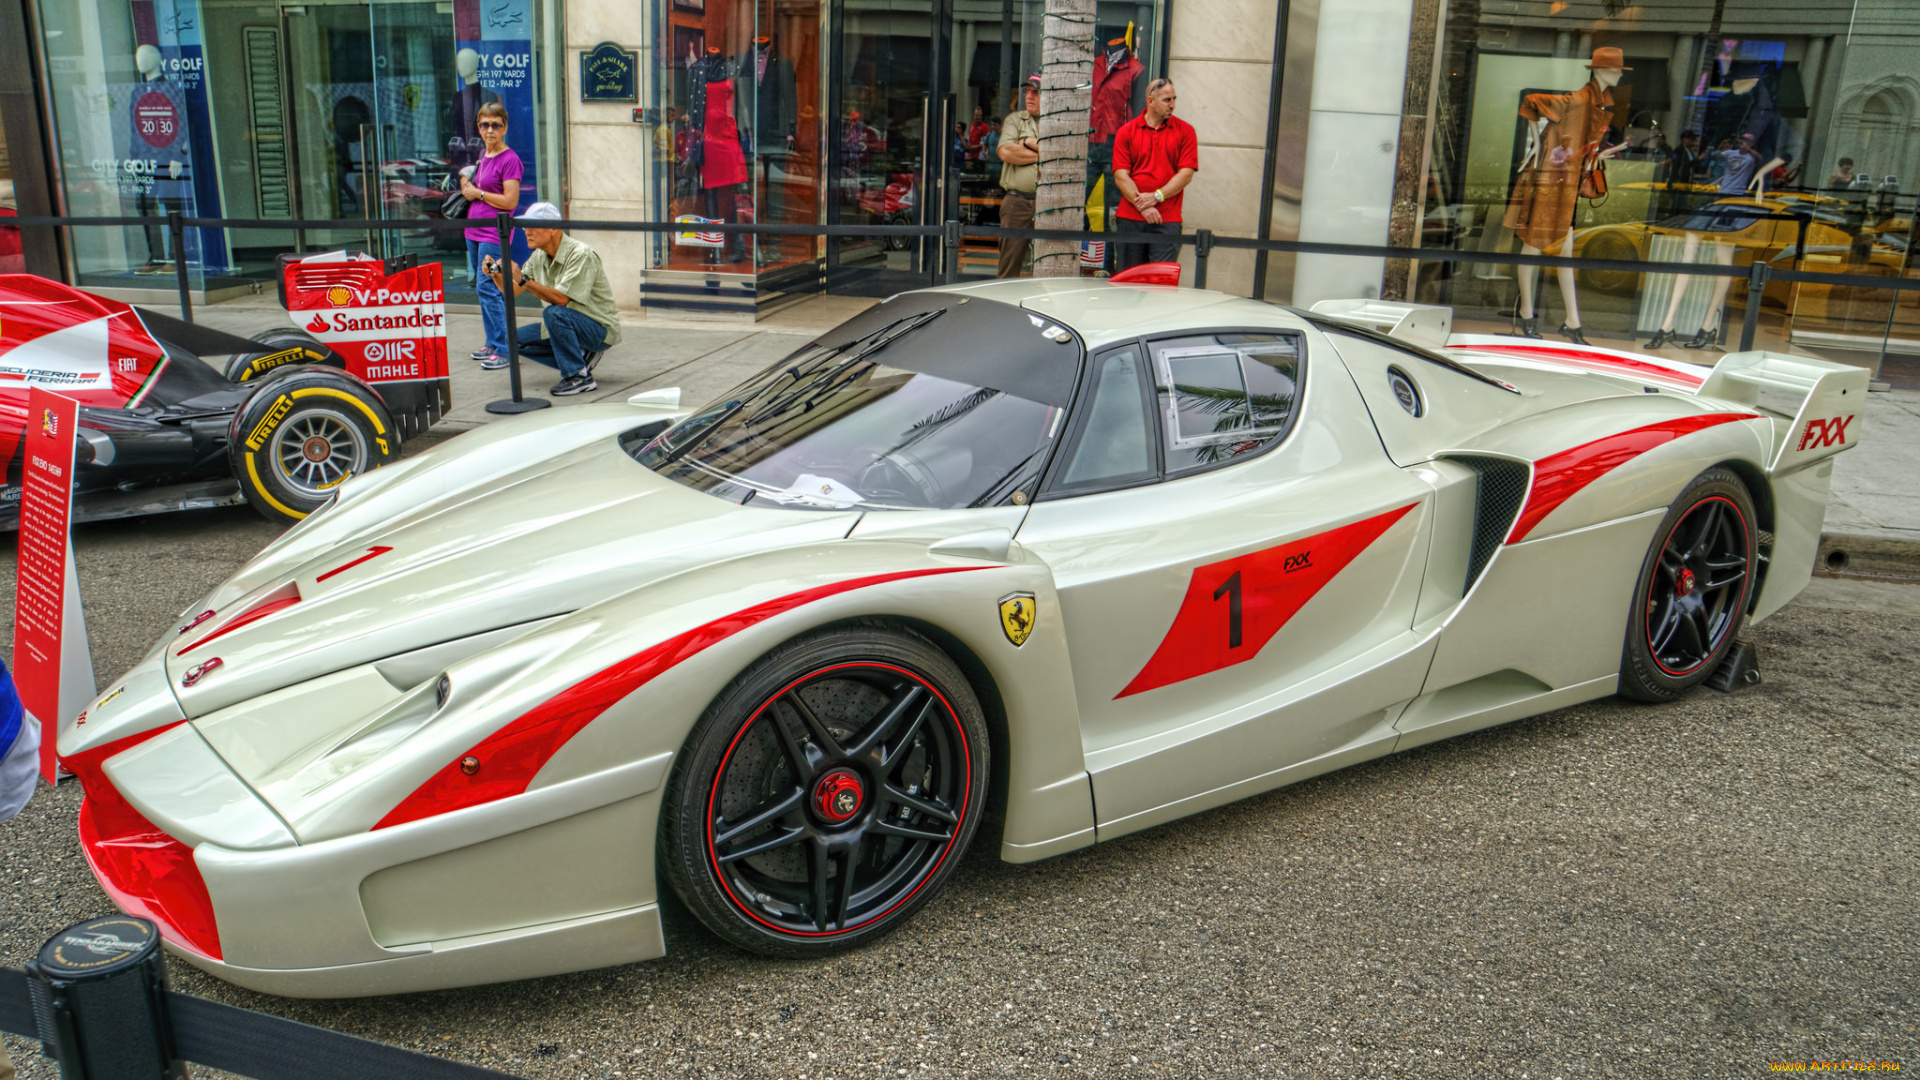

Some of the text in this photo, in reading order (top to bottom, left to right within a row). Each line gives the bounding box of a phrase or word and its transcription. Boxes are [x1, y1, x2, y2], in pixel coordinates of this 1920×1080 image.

[170, 58, 202, 71] GOLF
[492, 53, 530, 68] GOLF
[475, 69, 526, 78] GTH 197 YARDS
[488, 79, 496, 88] 12
[500, 79, 514, 88] PAR
[141, 120, 155, 133] 20
[160, 120, 173, 133] 30
[91, 158, 158, 174] CITY GOLF
[355, 288, 441, 306] V-Power
[333, 307, 443, 332] Santander
[118, 357, 138, 372] FIAT
[251, 346, 304, 372] PIRELLI
[0, 365, 78, 379] SCUDERIA
[367, 363, 419, 379] MAHLE
[27, 375, 98, 385] FERRARI
[245, 394, 295, 452] PIRELLI
[1800, 414, 1855, 451] FXX
[316, 545, 395, 583] 1
[1283, 551, 1311, 571] FXX
[1213, 570, 1243, 649] 1
